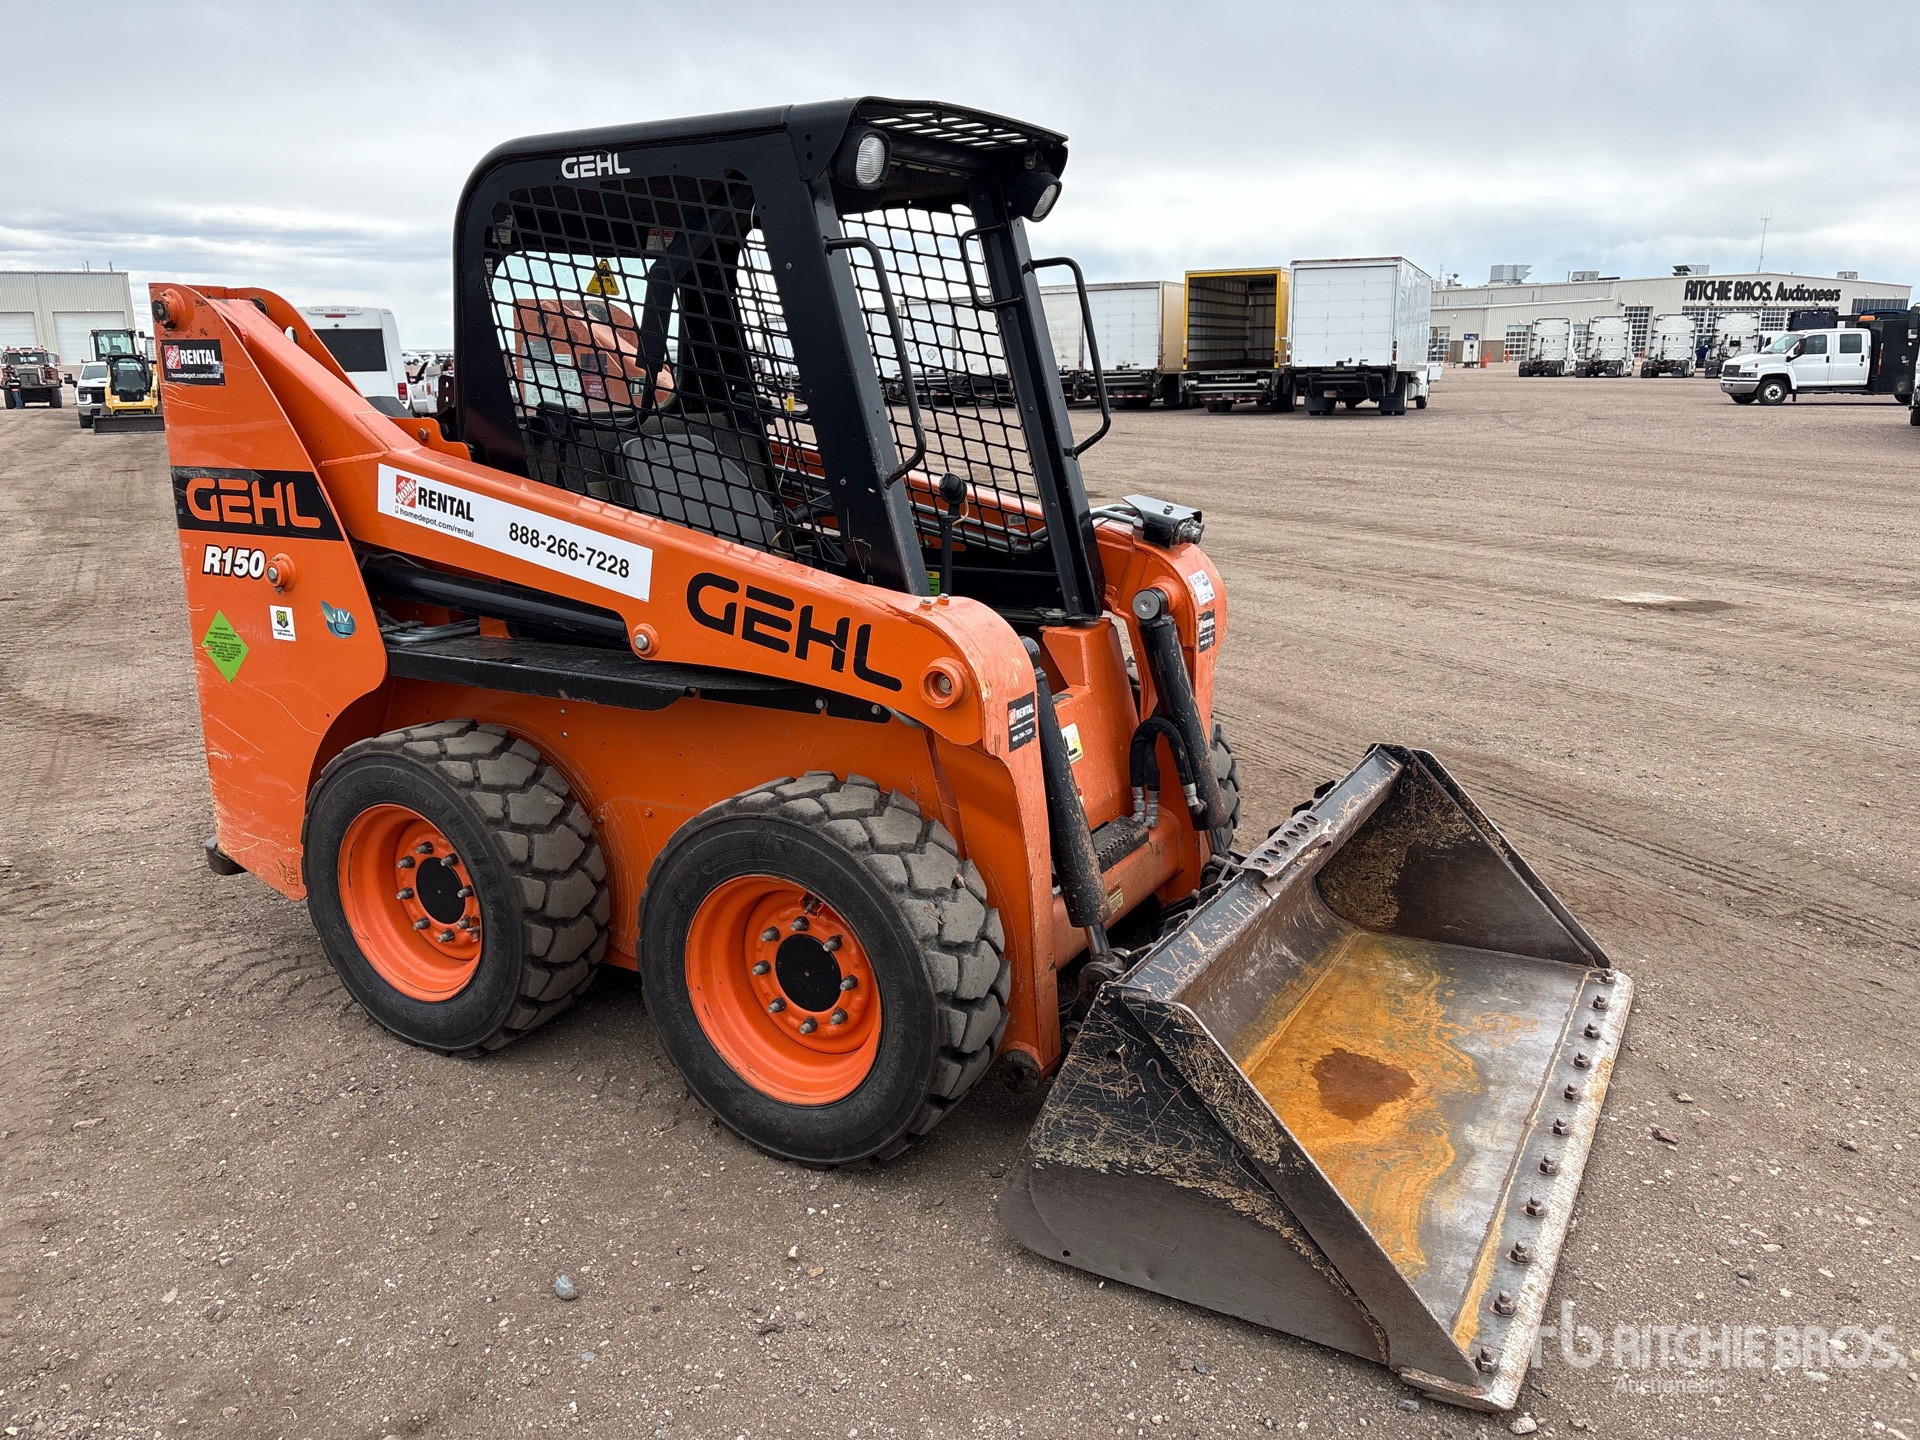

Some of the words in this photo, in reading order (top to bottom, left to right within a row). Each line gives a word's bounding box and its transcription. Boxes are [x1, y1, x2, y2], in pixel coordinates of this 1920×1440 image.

[561, 153, 631, 179] GEHL
[1684, 280, 1733, 301] RITCHIE
[1733, 281, 1773, 301] BROS.
[1775, 282, 1842, 302] Auctioneers
[180, 349, 219, 365] RENTAL
[170, 372, 221, 380] homedepot.com/rental
[186, 478, 321, 529] GEHL
[418, 486, 474, 522] RENTAL
[400, 508, 474, 538] homedepot.com/rental
[202, 544, 266, 580] R150
[509, 522, 630, 578] 888-266-7228
[687, 572, 902, 692] GEHL
